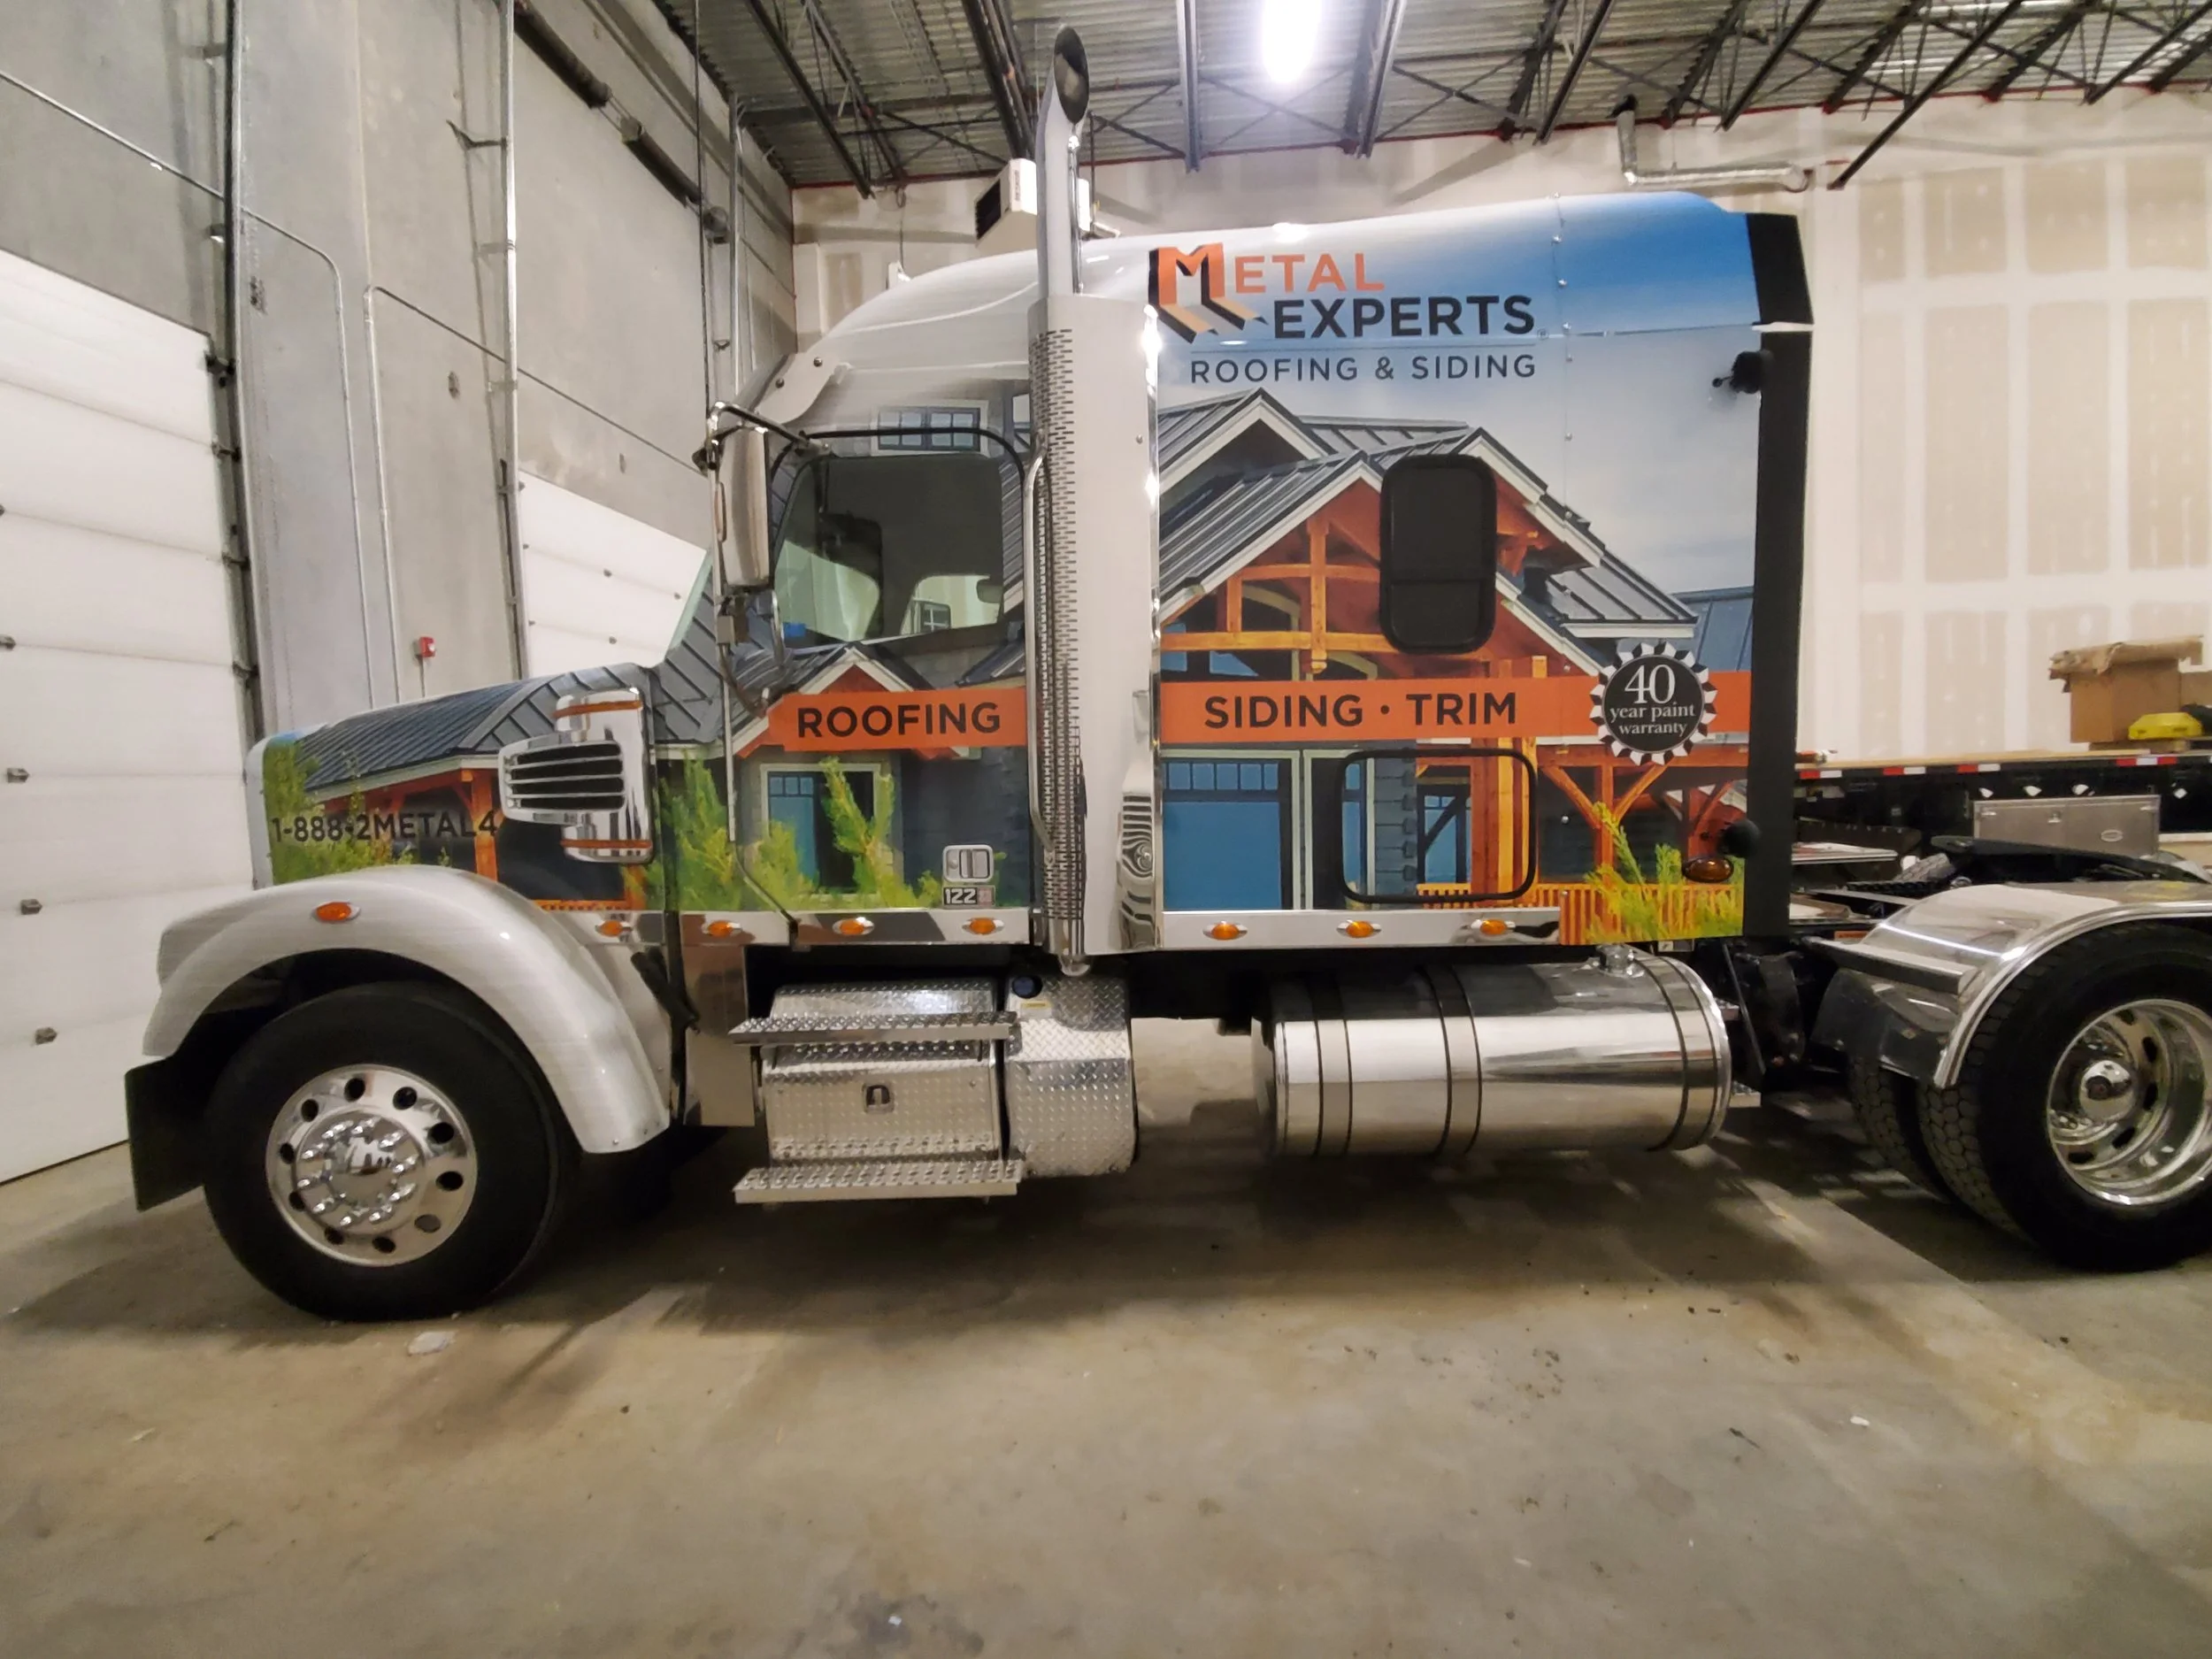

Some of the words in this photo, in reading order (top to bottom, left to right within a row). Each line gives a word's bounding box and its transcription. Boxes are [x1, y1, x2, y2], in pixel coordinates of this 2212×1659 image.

[1148, 242, 1385, 311] METAL
[1190, 356, 1358, 384] ROOFING
[1375, 356, 1395, 380] &
[1411, 354, 1536, 380] SIDING
[1624, 664, 1676, 703] 40
[797, 702, 1001, 738] ROOFING
[1204, 695, 1364, 729] SIDING
[1405, 692, 1517, 726] TRIM
[1610, 707, 1647, 723] year
[1651, 703, 1695, 722] paint
[1619, 722, 1687, 737] warranty
[271, 810, 497, 842] 1-888-2METAL4
[945, 887, 977, 904] 122
